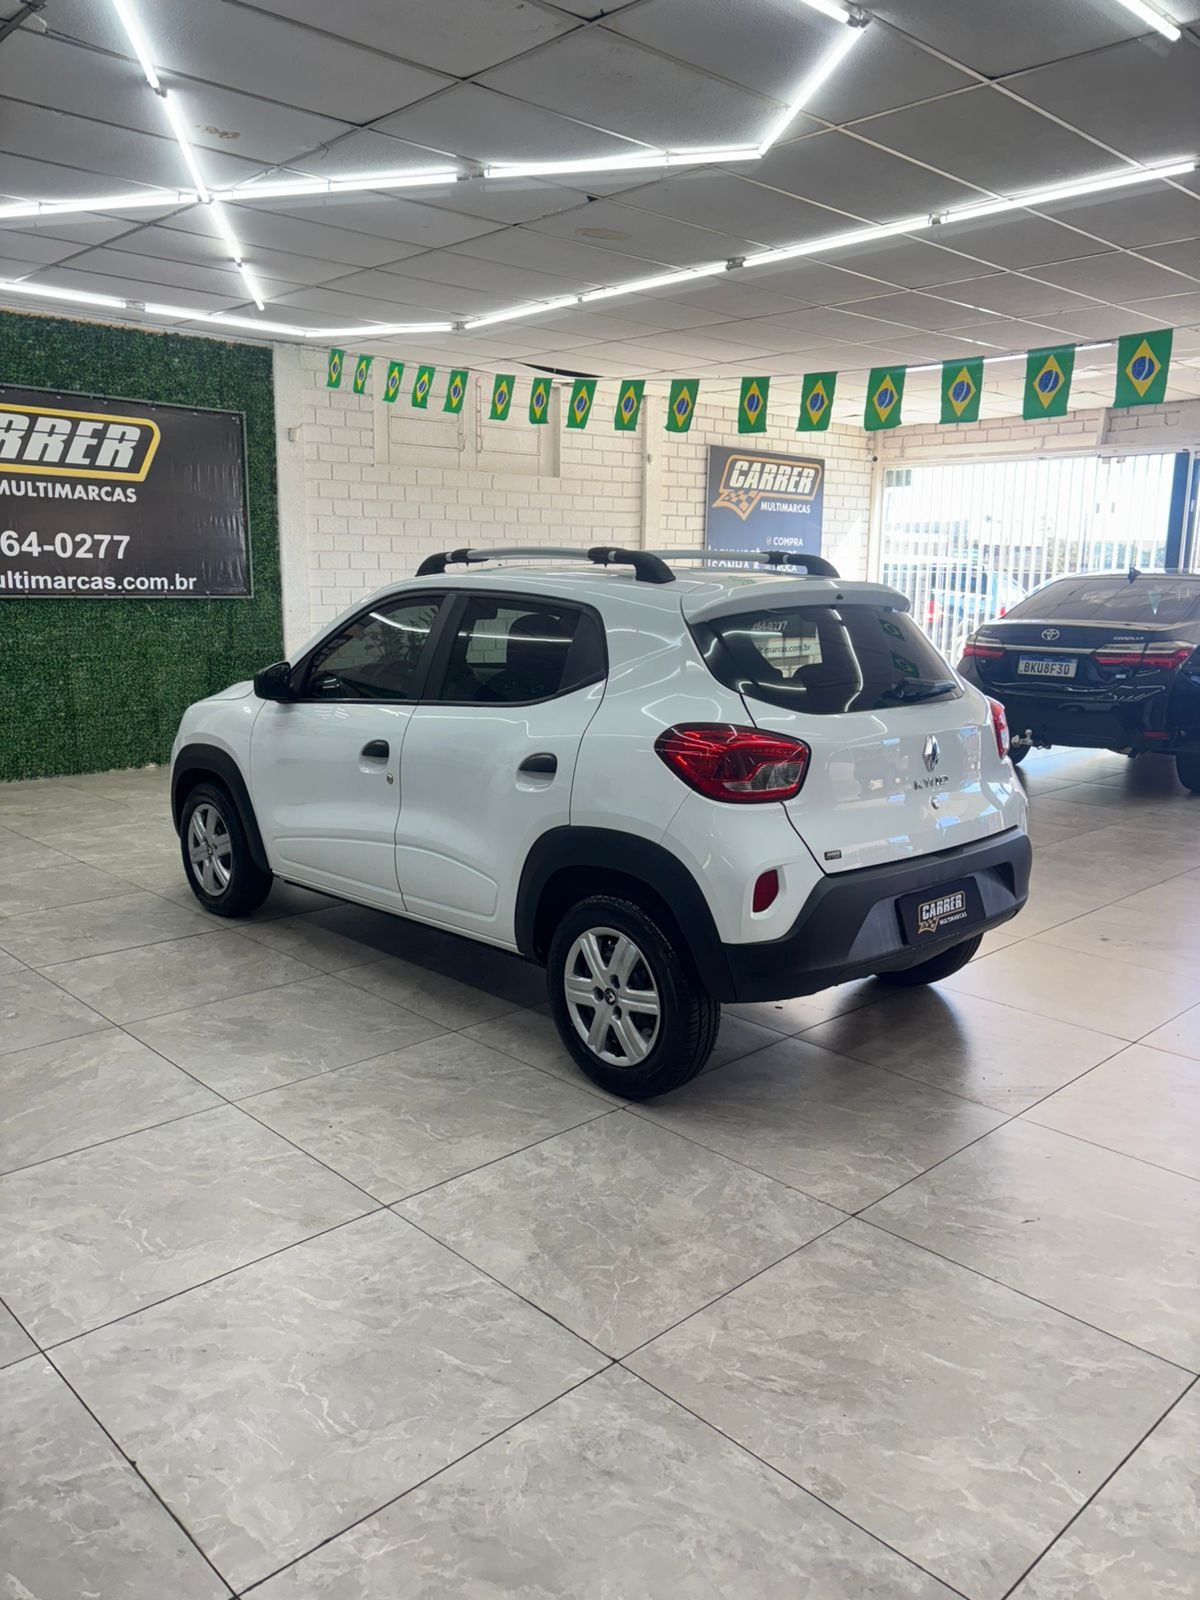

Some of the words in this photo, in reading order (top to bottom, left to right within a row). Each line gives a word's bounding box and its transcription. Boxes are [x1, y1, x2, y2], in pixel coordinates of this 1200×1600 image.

[729, 461, 815, 494] CARRER
[760, 501, 811, 514] MULTIMARCAS
[0, 530, 130, 559] 64-0277
[773, 536, 804, 547] COMPRA
[1023, 661, 1070, 675] BKU8F30
[922, 894, 962, 920] CARRER
